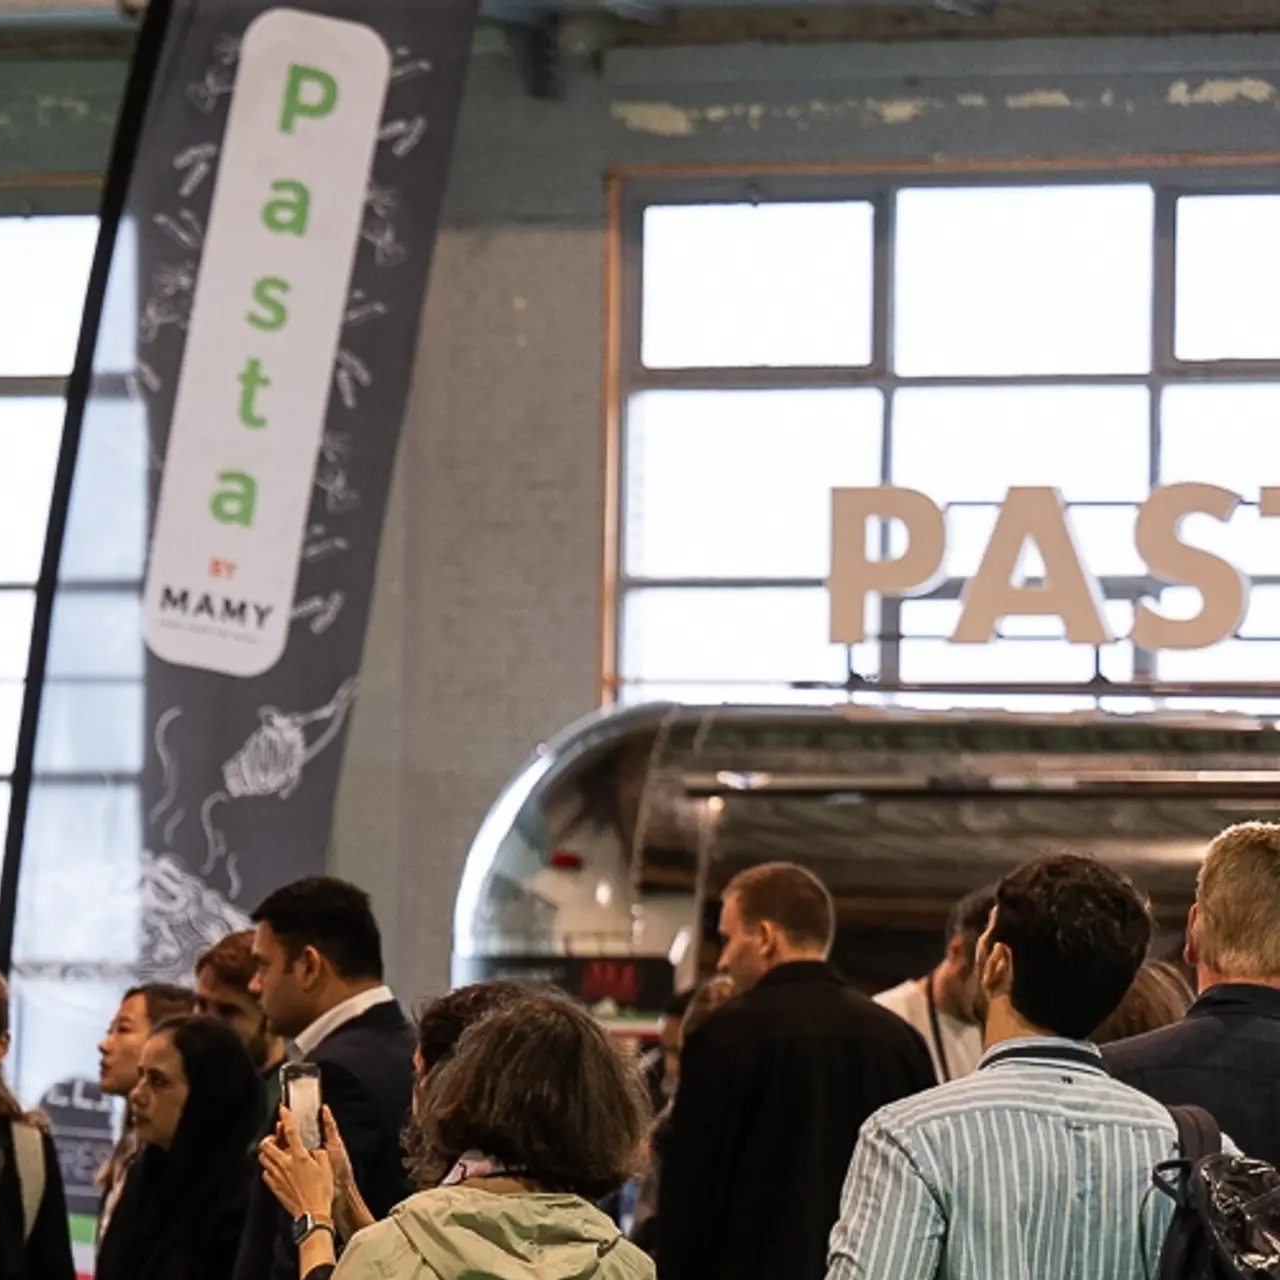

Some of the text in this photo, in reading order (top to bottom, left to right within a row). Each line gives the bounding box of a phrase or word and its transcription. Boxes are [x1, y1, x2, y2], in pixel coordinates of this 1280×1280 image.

[207, 62, 340, 529] Pasta
[159, 586, 274, 629] MAMY
[207, 557, 237, 580] BY
[828, 482, 1280, 650] PAS
